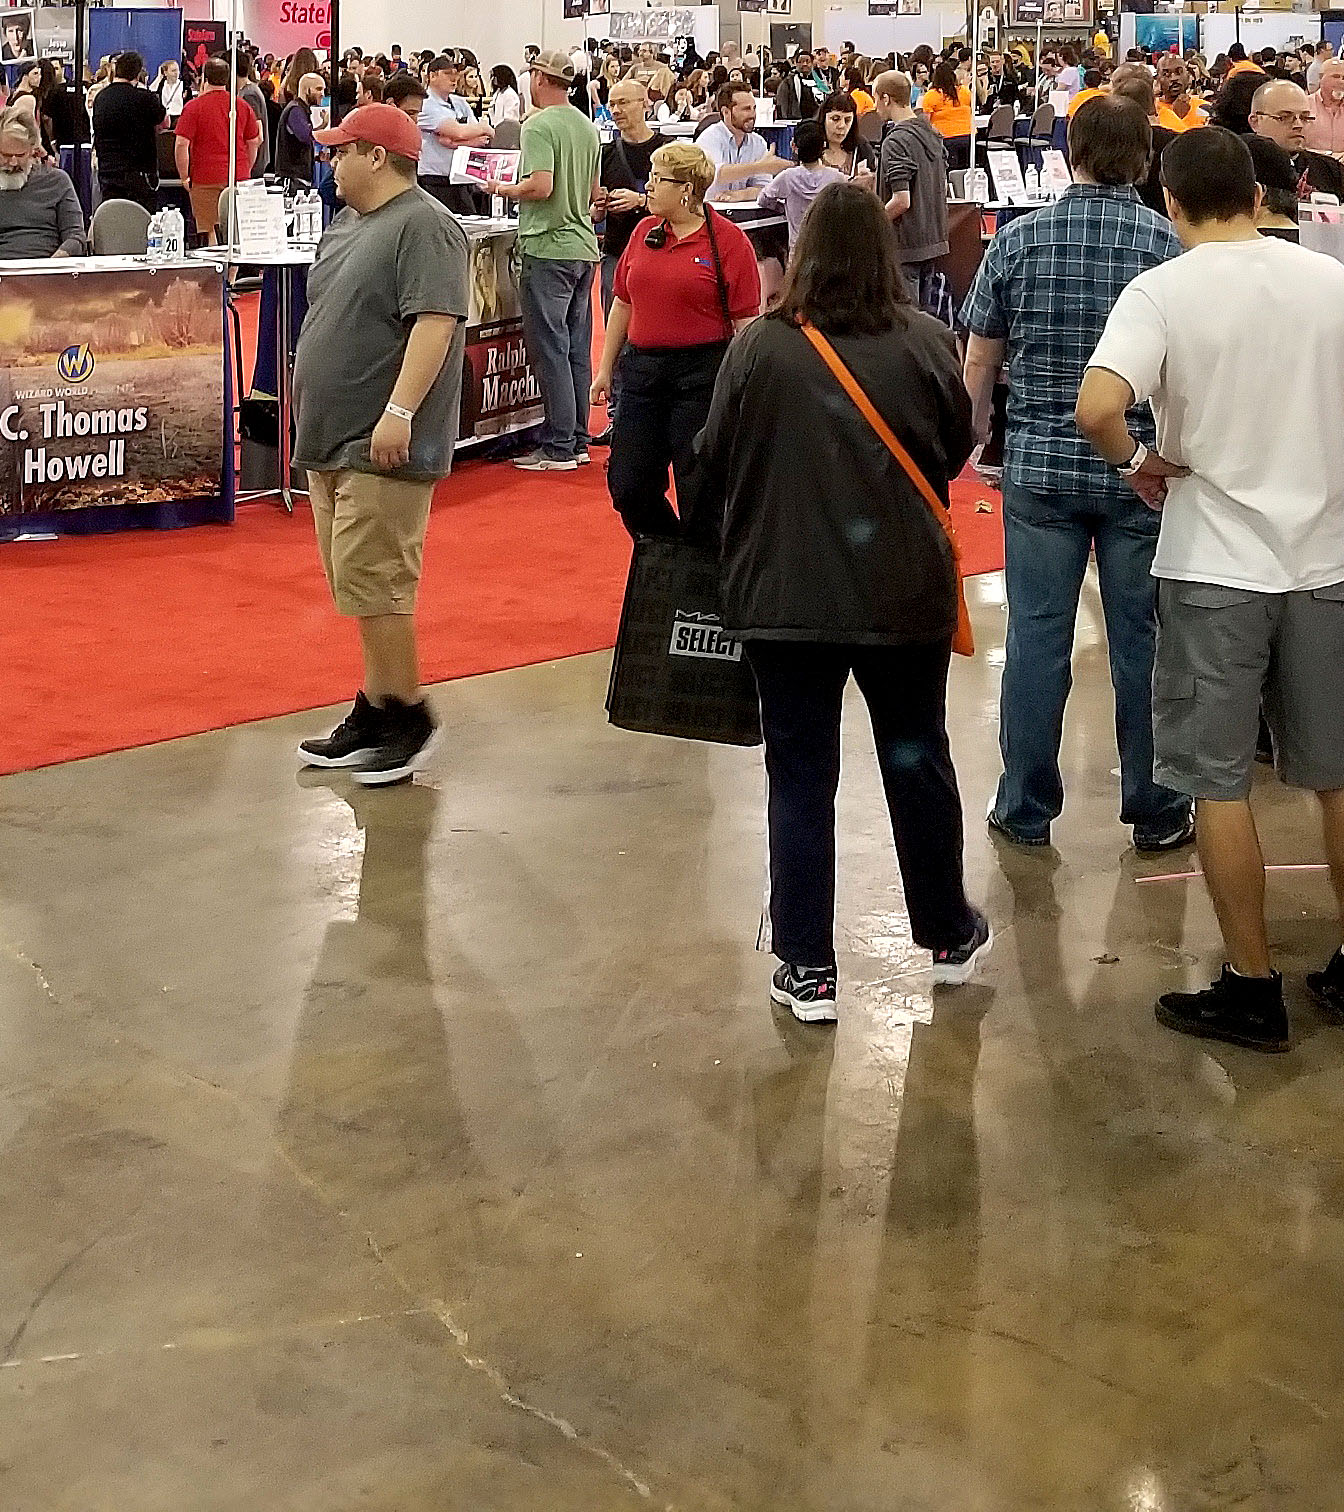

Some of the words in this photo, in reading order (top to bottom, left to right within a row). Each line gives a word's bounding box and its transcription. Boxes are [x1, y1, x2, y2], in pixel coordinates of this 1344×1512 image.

[165, 238, 178, 252] 20
[485, 338, 526, 376] Ralph
[15, 388, 53, 400] WIZARD
[54, 386, 88, 398] WORLD
[0, 404, 29, 441] C.
[39, 400, 148, 439] Thomas
[24, 439, 125, 484] Howell
